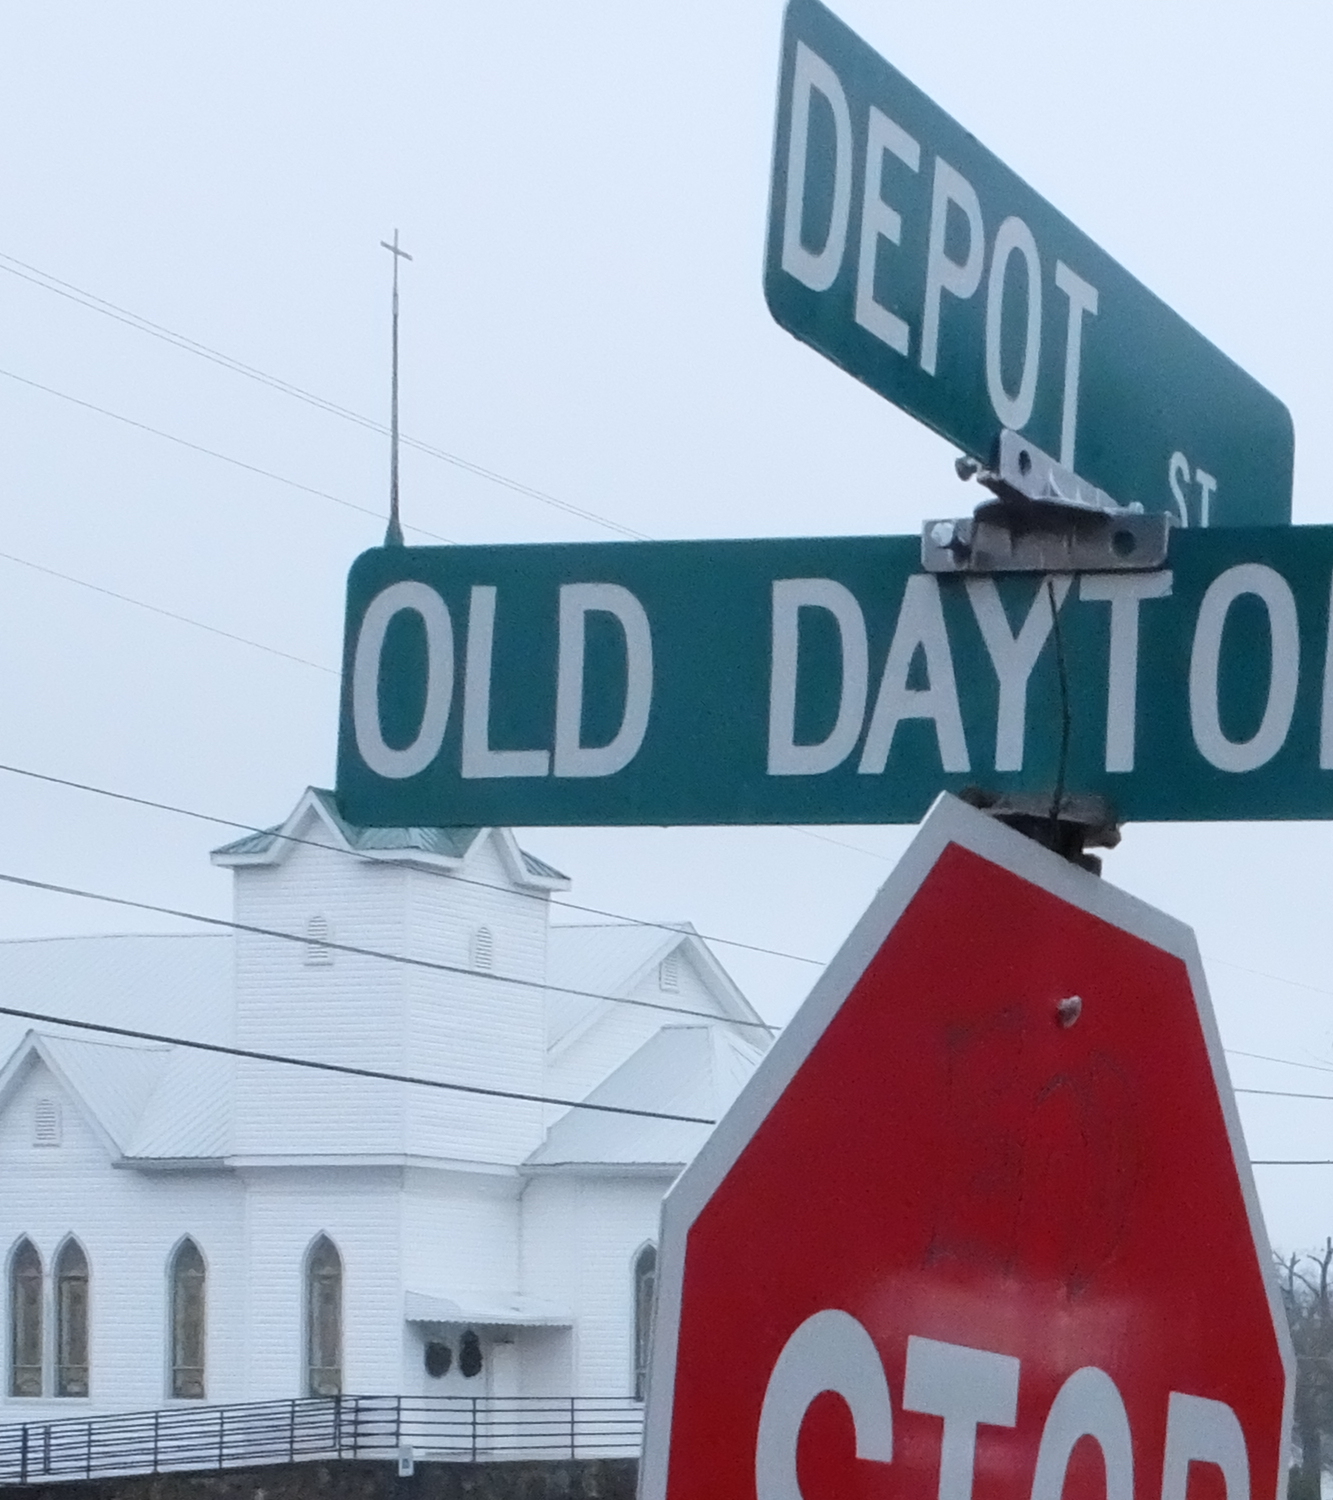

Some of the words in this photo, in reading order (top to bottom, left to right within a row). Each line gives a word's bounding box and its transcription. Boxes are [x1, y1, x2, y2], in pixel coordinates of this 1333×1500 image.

[782, 40, 1098, 472] DEPOT
[1169, 451, 1217, 528] ST
[353, 581, 654, 779] OLD
